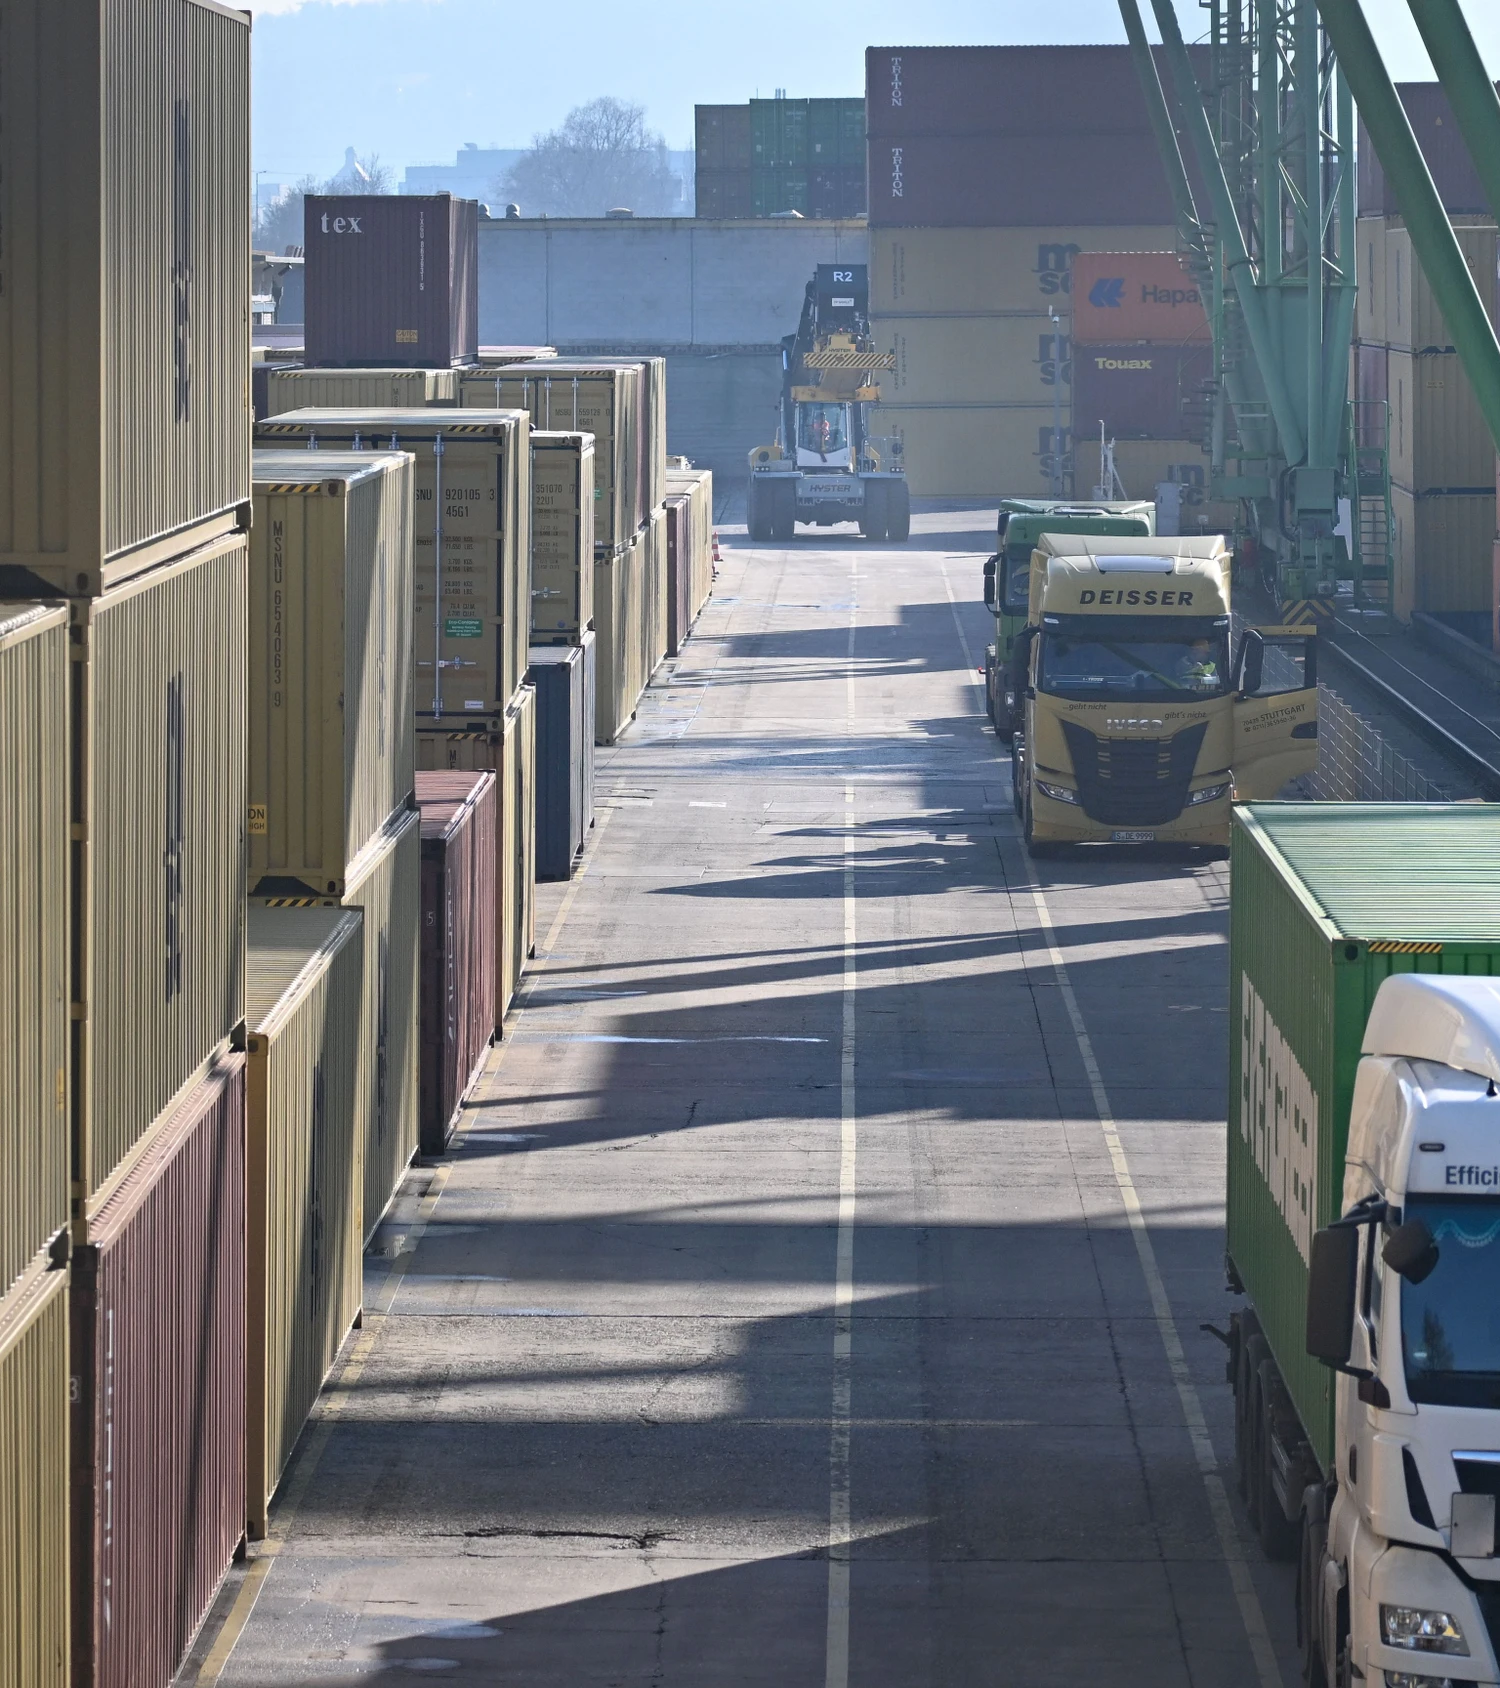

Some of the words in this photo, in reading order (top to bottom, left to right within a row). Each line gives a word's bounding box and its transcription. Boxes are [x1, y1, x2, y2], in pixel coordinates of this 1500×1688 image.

[891, 57, 902, 106] TRITON
[891, 148, 903, 197] TRITON
[320, 212, 362, 234] tex
[833, 271, 853, 282] R2
[1094, 357, 1152, 370] Touax
[415, 489, 432, 501] SNU
[445, 489, 481, 501] 920105
[489, 489, 496, 501] 3
[535, 484, 563, 494] 351070
[809, 484, 852, 493] HYSTER
[445, 505, 469, 518] 45G1
[273, 521, 283, 584] MSNU
[1079, 590, 1193, 606] DEISSER
[274, 590, 282, 684] 654063
[274, 691, 282, 707] 9
[1260, 703, 1306, 723] STUTTGART
[1107, 718, 1162, 731] IVECO
[1125, 832, 1135, 840] DE
[1135, 832, 1153, 840] 9999
